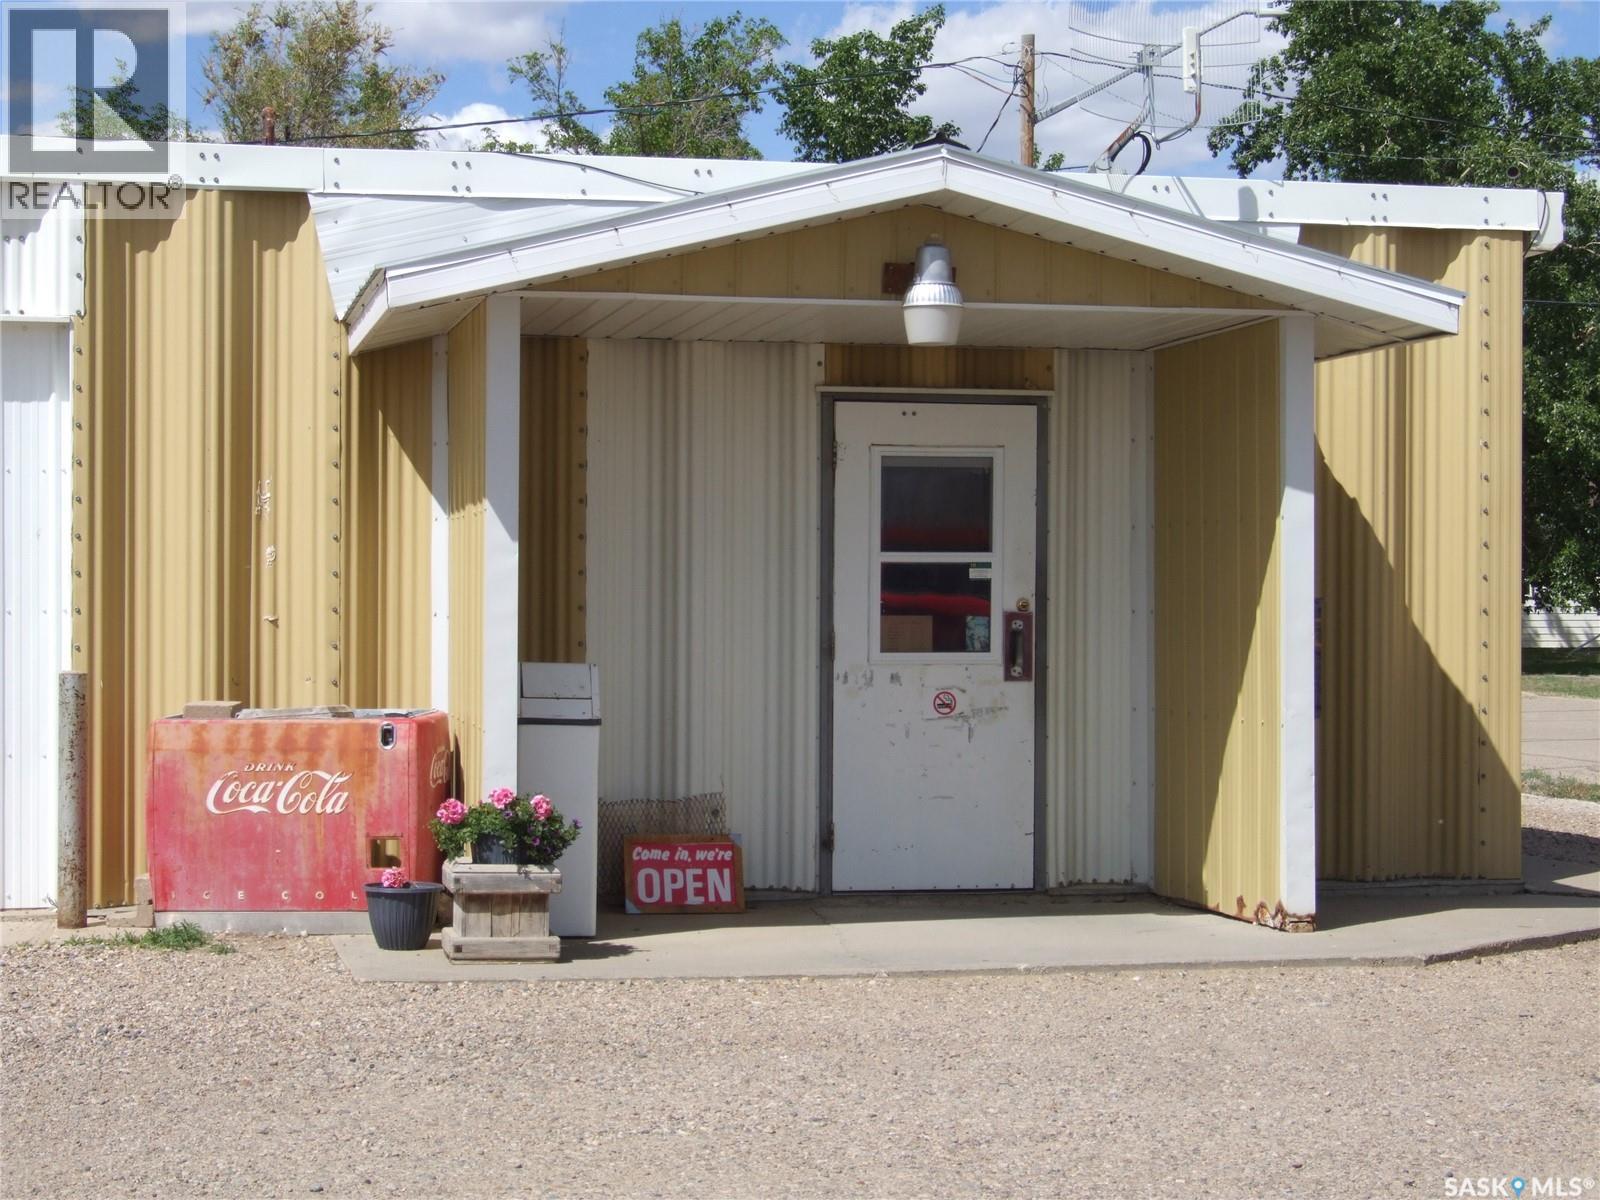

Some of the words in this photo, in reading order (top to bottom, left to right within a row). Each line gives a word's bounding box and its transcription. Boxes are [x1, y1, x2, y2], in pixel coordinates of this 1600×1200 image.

[244, 762, 297, 772] DRINK
[206, 770, 353, 815] Coca-Cola
[632, 846, 670, 861] Come
[675, 847, 691, 862] in,
[696, 848, 733, 861] we're
[637, 867, 732, 905] OPEN
[281, 890, 358, 900] COL
